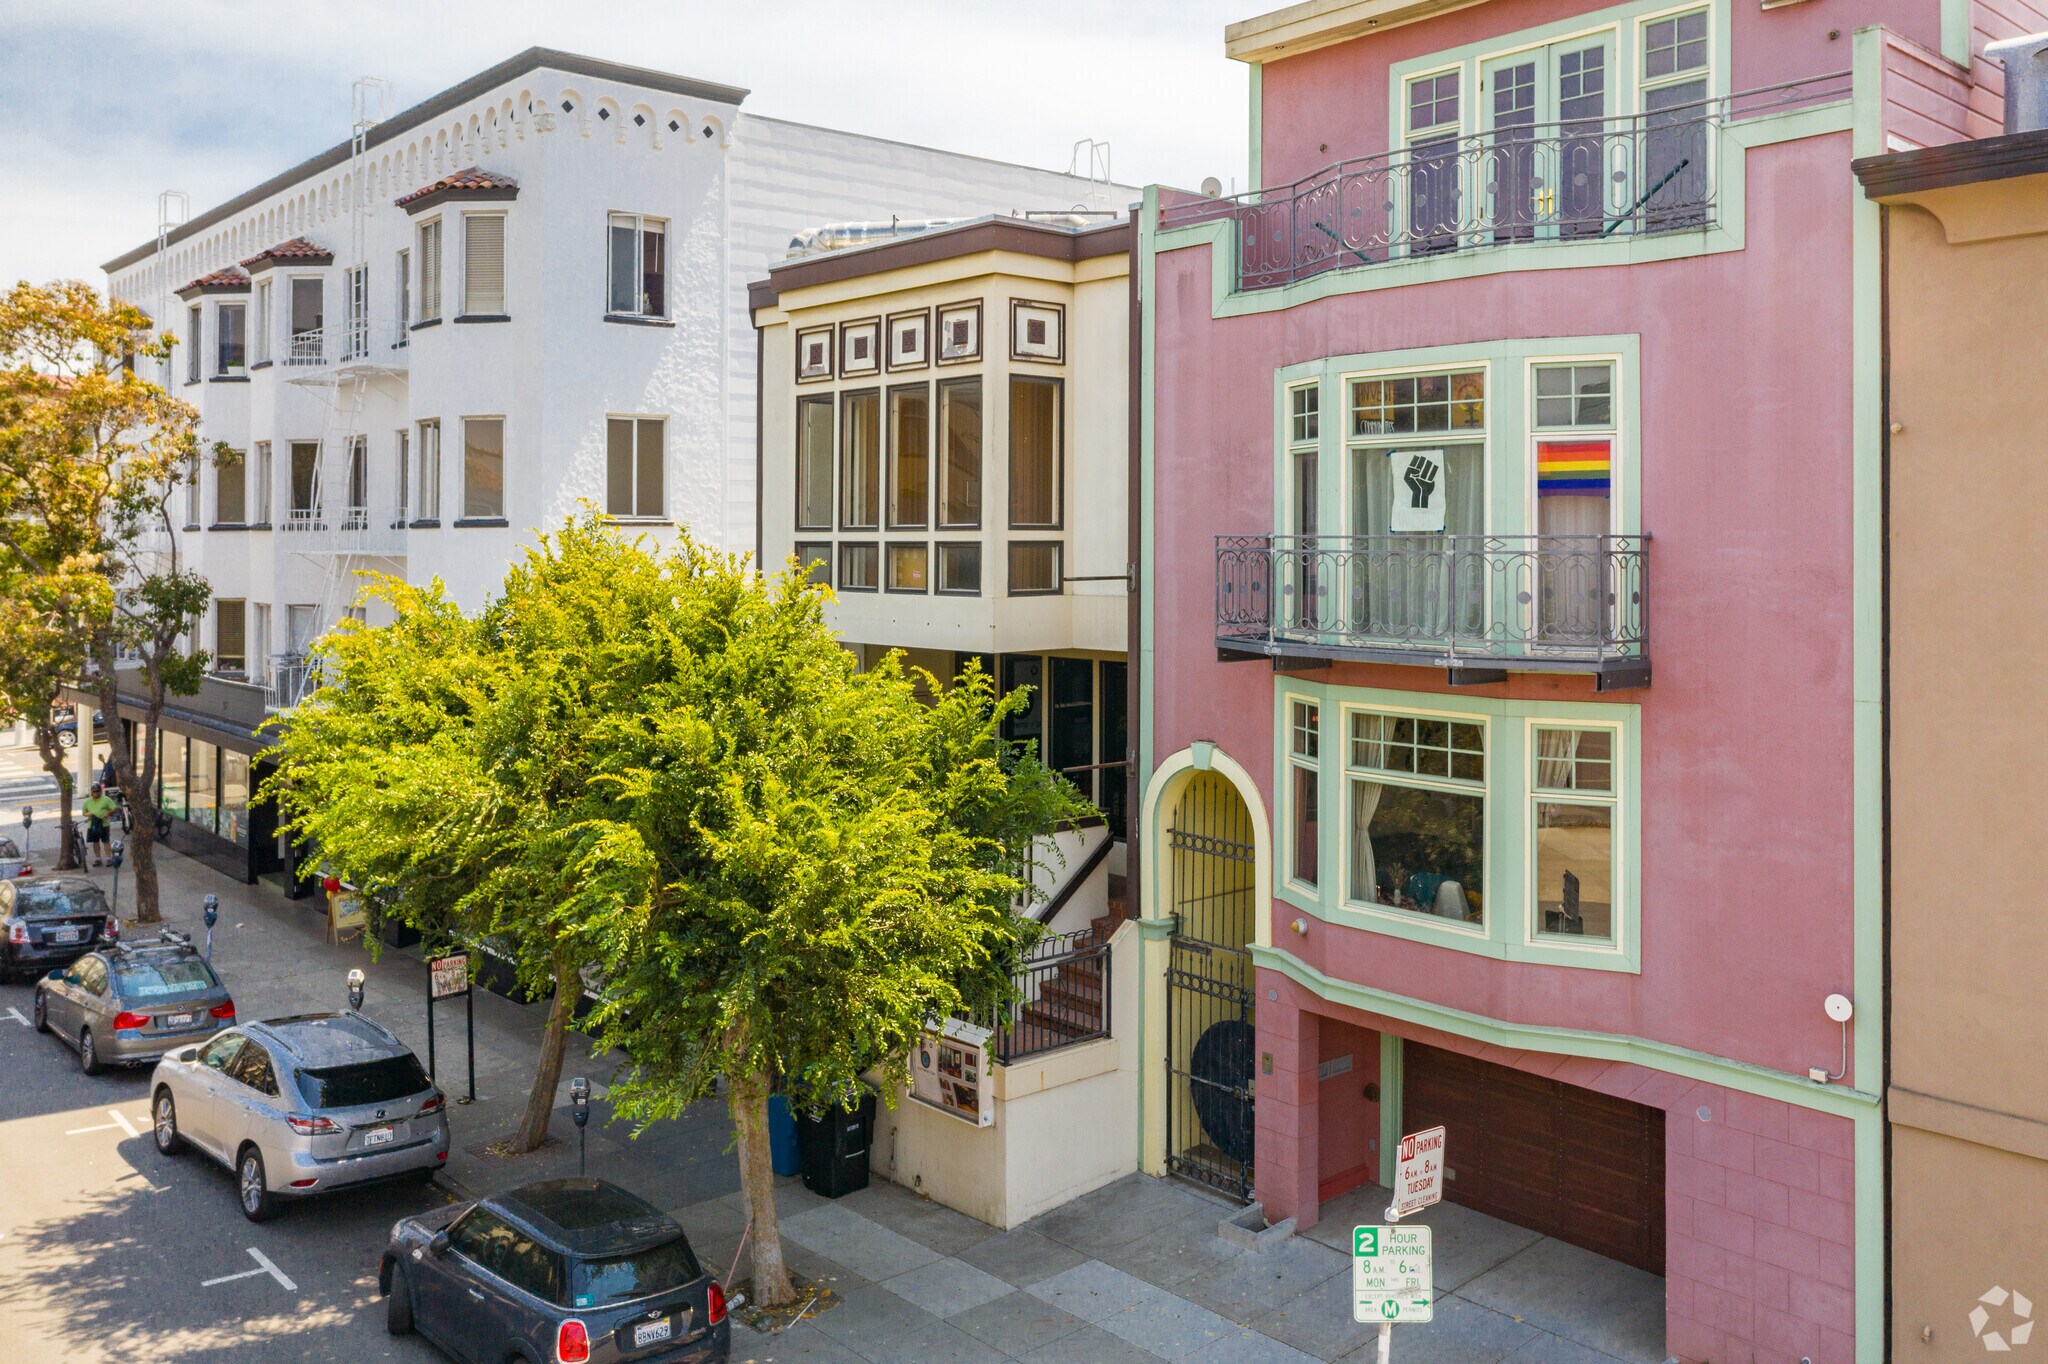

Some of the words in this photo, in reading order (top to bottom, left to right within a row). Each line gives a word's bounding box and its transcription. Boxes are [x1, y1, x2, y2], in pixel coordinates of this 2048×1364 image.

[432, 960, 442, 970] NO
[443, 958, 465, 969] PARKING
[1402, 1139, 1414, 1159] NO
[1416, 1135, 1442, 1154] PARKING
[1405, 1166, 1409, 1180] 6
[1425, 1160, 1430, 1173] 8
[1408, 1176, 1434, 1194] TUESDAY
[1401, 1198, 1417, 1210] STREET
[1418, 1192, 1438, 1204] CLEANING
[1359, 1233, 1374, 1252] 2
[1390, 1234, 1417, 1243] HOUR
[1382, 1245, 1425, 1255] PARKING
[1364, 1260, 1370, 1273] 8
[1399, 1260, 1407, 1273] 6
[1366, 1278, 1385, 1287] MON
[1406, 1278, 1419, 1287] FRI
